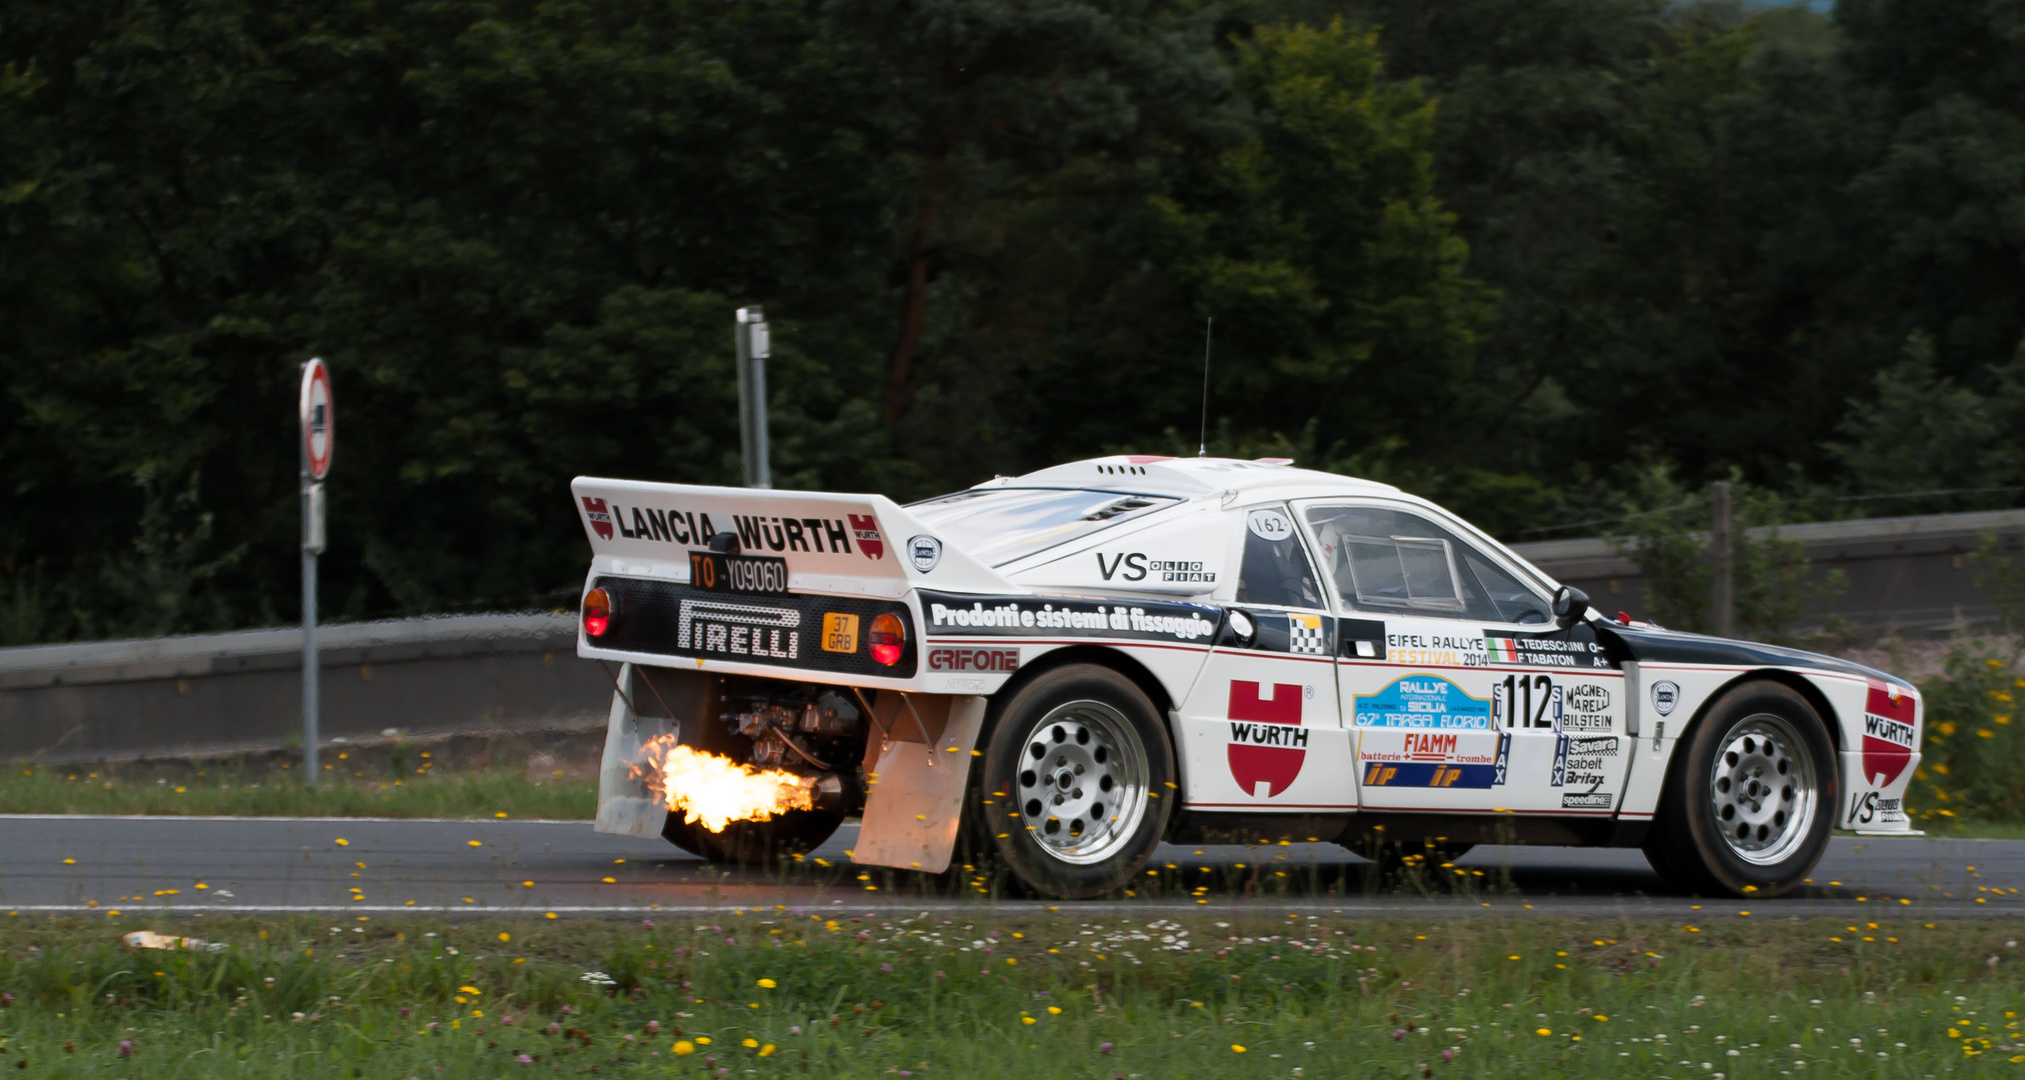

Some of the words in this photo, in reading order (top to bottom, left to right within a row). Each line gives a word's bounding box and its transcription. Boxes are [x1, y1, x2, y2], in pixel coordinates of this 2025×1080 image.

[612, 505, 718, 546] LANCIA
[732, 515, 852, 553] WÜRTH
[1254, 517, 1285, 533] 162
[691, 555, 715, 588] TO
[726, 559, 785, 592] Y09060
[1096, 552, 1147, 581] VS
[1150, 561, 1203, 571] OLIO
[1163, 572, 1216, 582] FIAT
[678, 599, 800, 659] PIRELLI
[833, 616, 849, 632] 37
[931, 603, 1020, 627] Prodotti
[1020, 610, 1035, 628] e
[1036, 604, 1108, 629] sistemi
[1109, 606, 1130, 630] di
[1130, 607, 1214, 639] fissaggio
[828, 633, 851, 650] GRB
[1387, 634, 1427, 648] EIFEL
[1432, 636, 1484, 650] RALLYE
[1522, 639, 1585, 652] TEDESCHINI
[928, 649, 1018, 671] GRIFONE
[1388, 650, 1460, 665] FESTIVAL
[1463, 653, 1488, 666] 2014
[1525, 653, 1574, 665] TABATON
[1593, 656, 1608, 667] A+
[1400, 681, 1448, 694] RALLYE
[1566, 684, 1610, 704] MAGNETI
[1407, 701, 1447, 713] SICILIA
[1503, 675, 1552, 728] 112
[1384, 713, 1433, 727] TARGA
[1440, 715, 1487, 728] FLORIO
[1563, 714, 1612, 727] BILSTEIN
[1231, 722, 1309, 747] WÜRTH
[1865, 714, 1913, 746] WÜRTH
[1404, 733, 1457, 753] FIAMM
[1570, 739, 1617, 754] Savara
[1361, 751, 1400, 760] batterie
[1456, 754, 1491, 763] trombe
[1566, 758, 1602, 769] sabelt
[1565, 771, 1604, 784] Britax
[1563, 795, 1605, 805] speedline
[1847, 791, 1879, 823] VS
